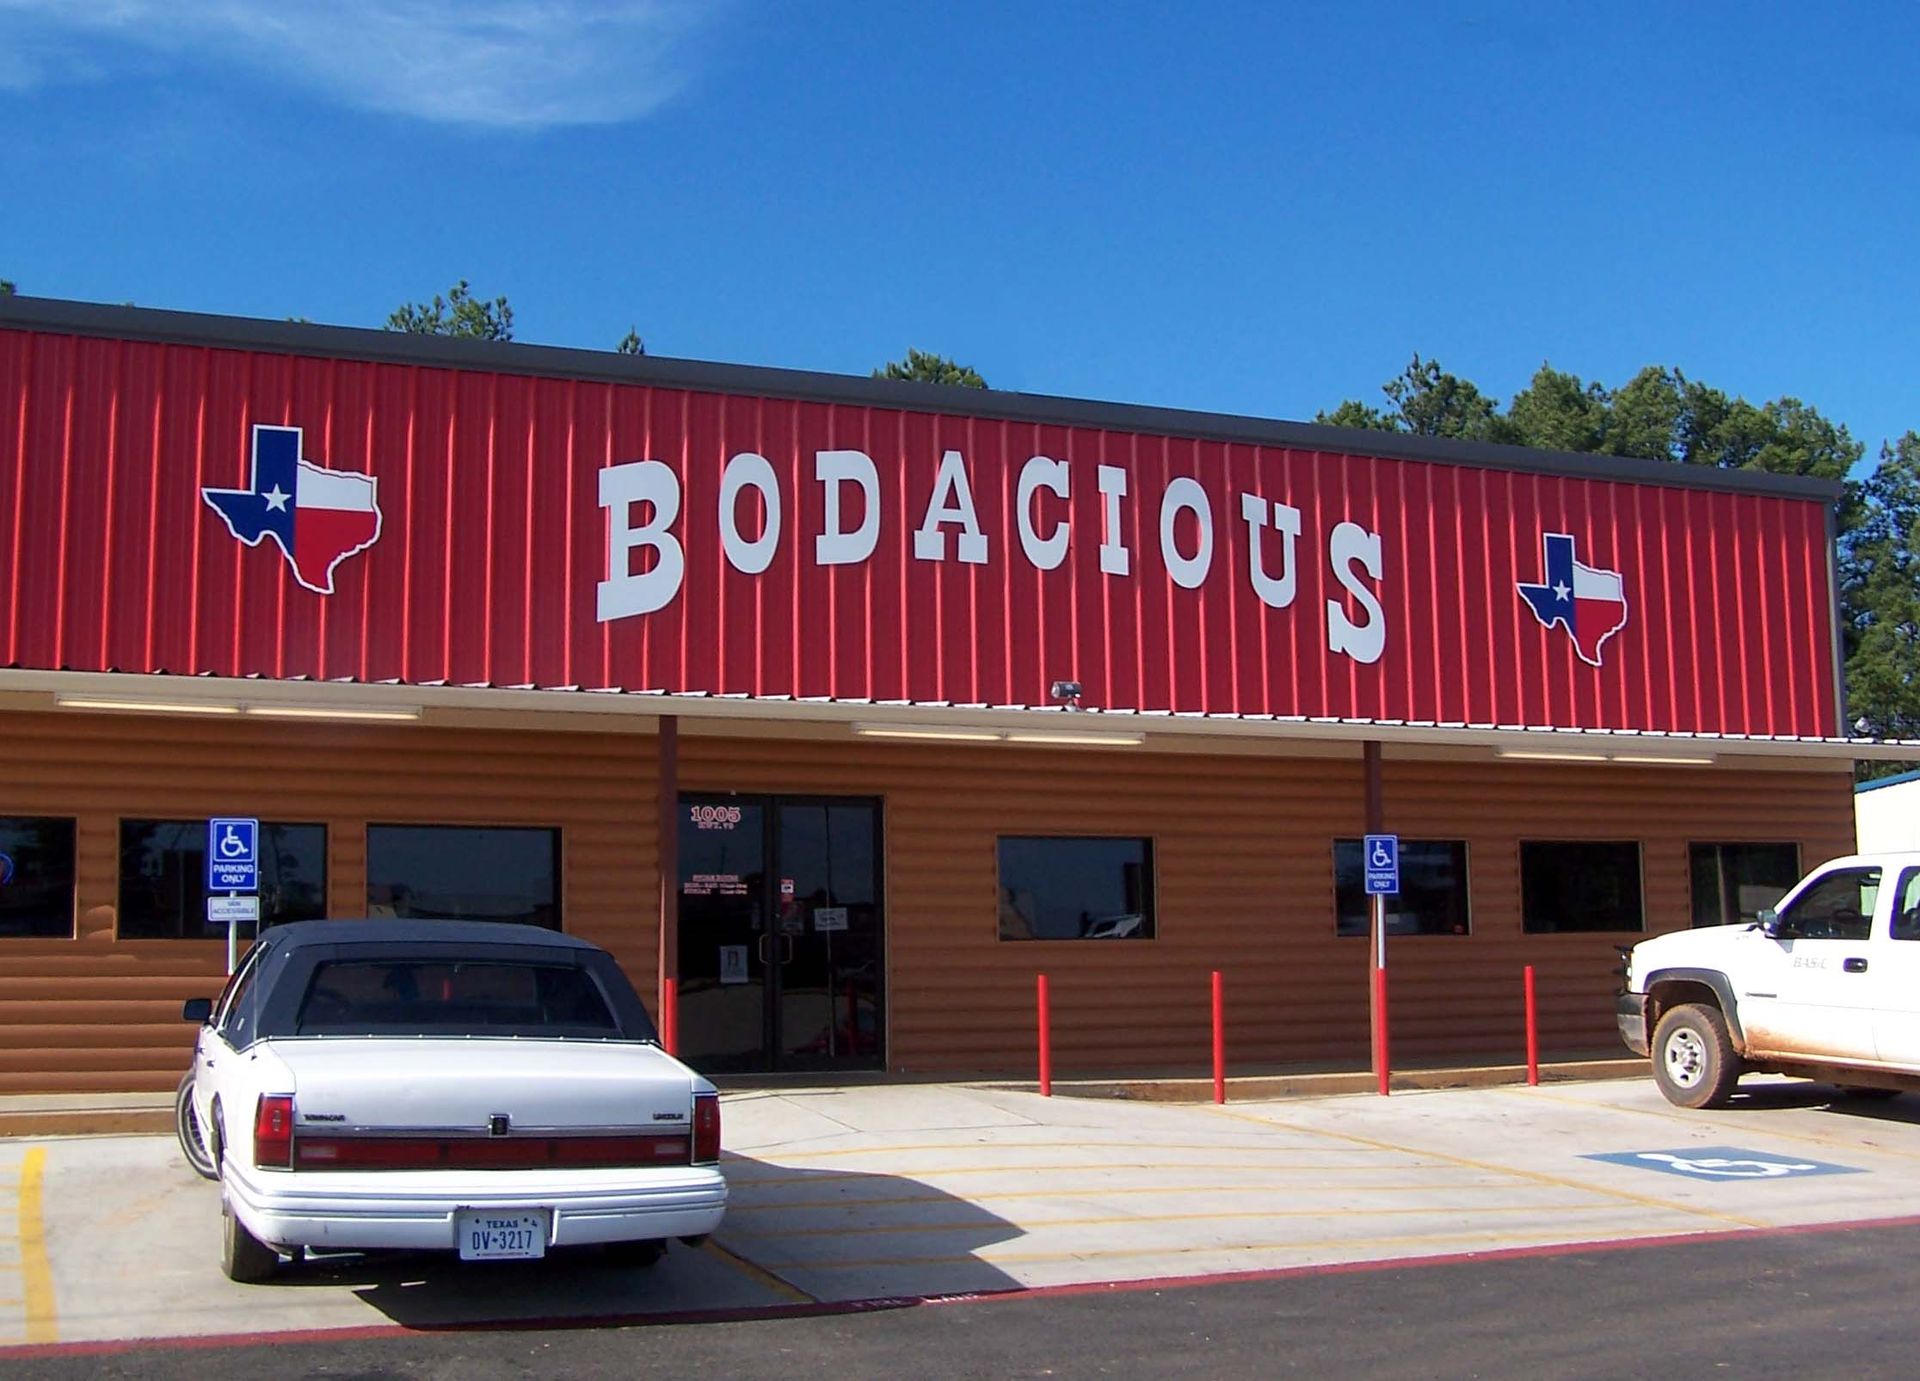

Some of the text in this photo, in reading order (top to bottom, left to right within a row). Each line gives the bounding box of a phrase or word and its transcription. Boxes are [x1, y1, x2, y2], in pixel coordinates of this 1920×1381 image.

[597, 449, 1386, 665] BODACIOUS
[690, 806, 741, 823] 1005
[213, 864, 254, 874] PARKING
[221, 874, 246, 884] ONLY
[486, 1220, 518, 1229] TEXAS
